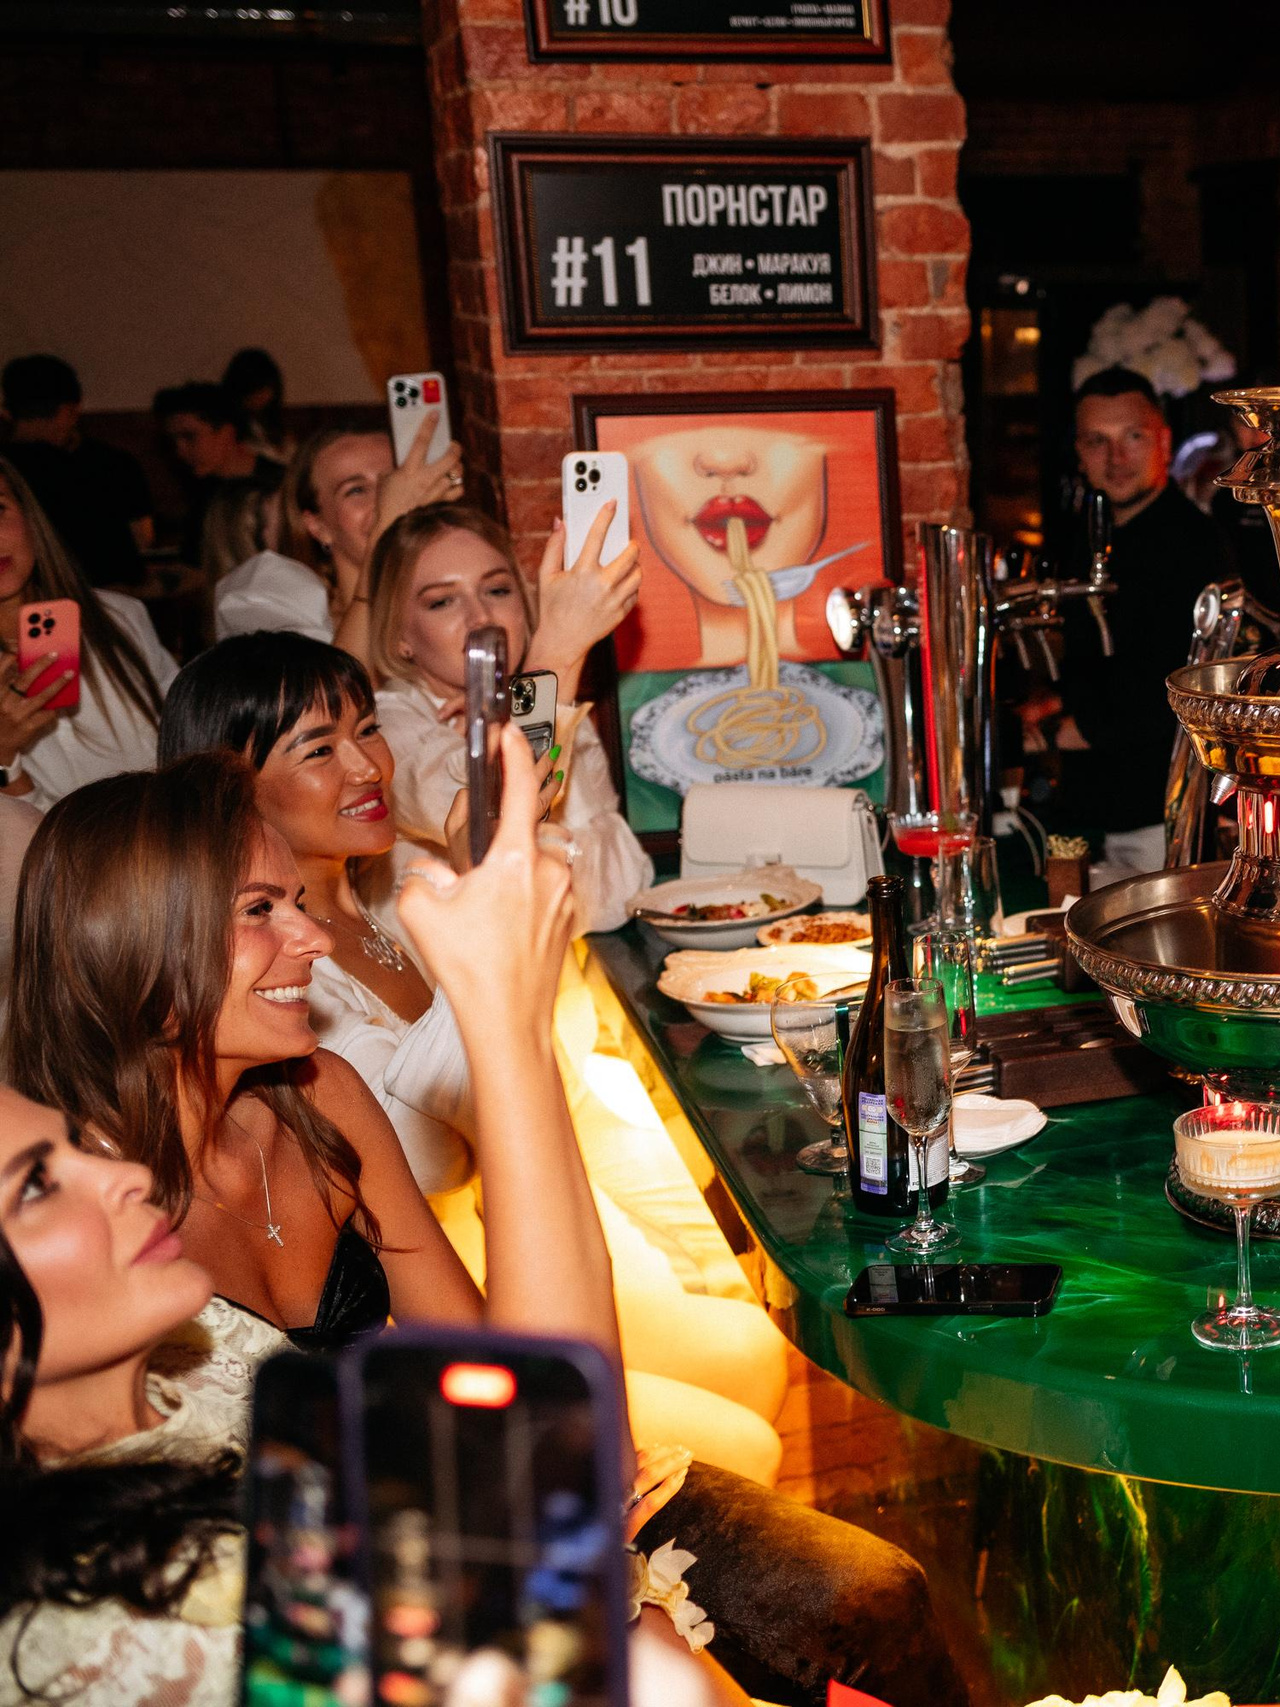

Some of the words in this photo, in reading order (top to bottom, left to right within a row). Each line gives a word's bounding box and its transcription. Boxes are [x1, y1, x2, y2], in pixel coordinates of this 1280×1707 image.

[661, 183, 828, 227] ПОРНСТАР
[550, 236, 651, 307] #11
[692, 253, 743, 277] ДЖИН
[757, 252, 831, 275] МАРАКУЯ
[709, 283, 763, 305] БЕЛОК
[776, 282, 833, 304] ЛИМОН
